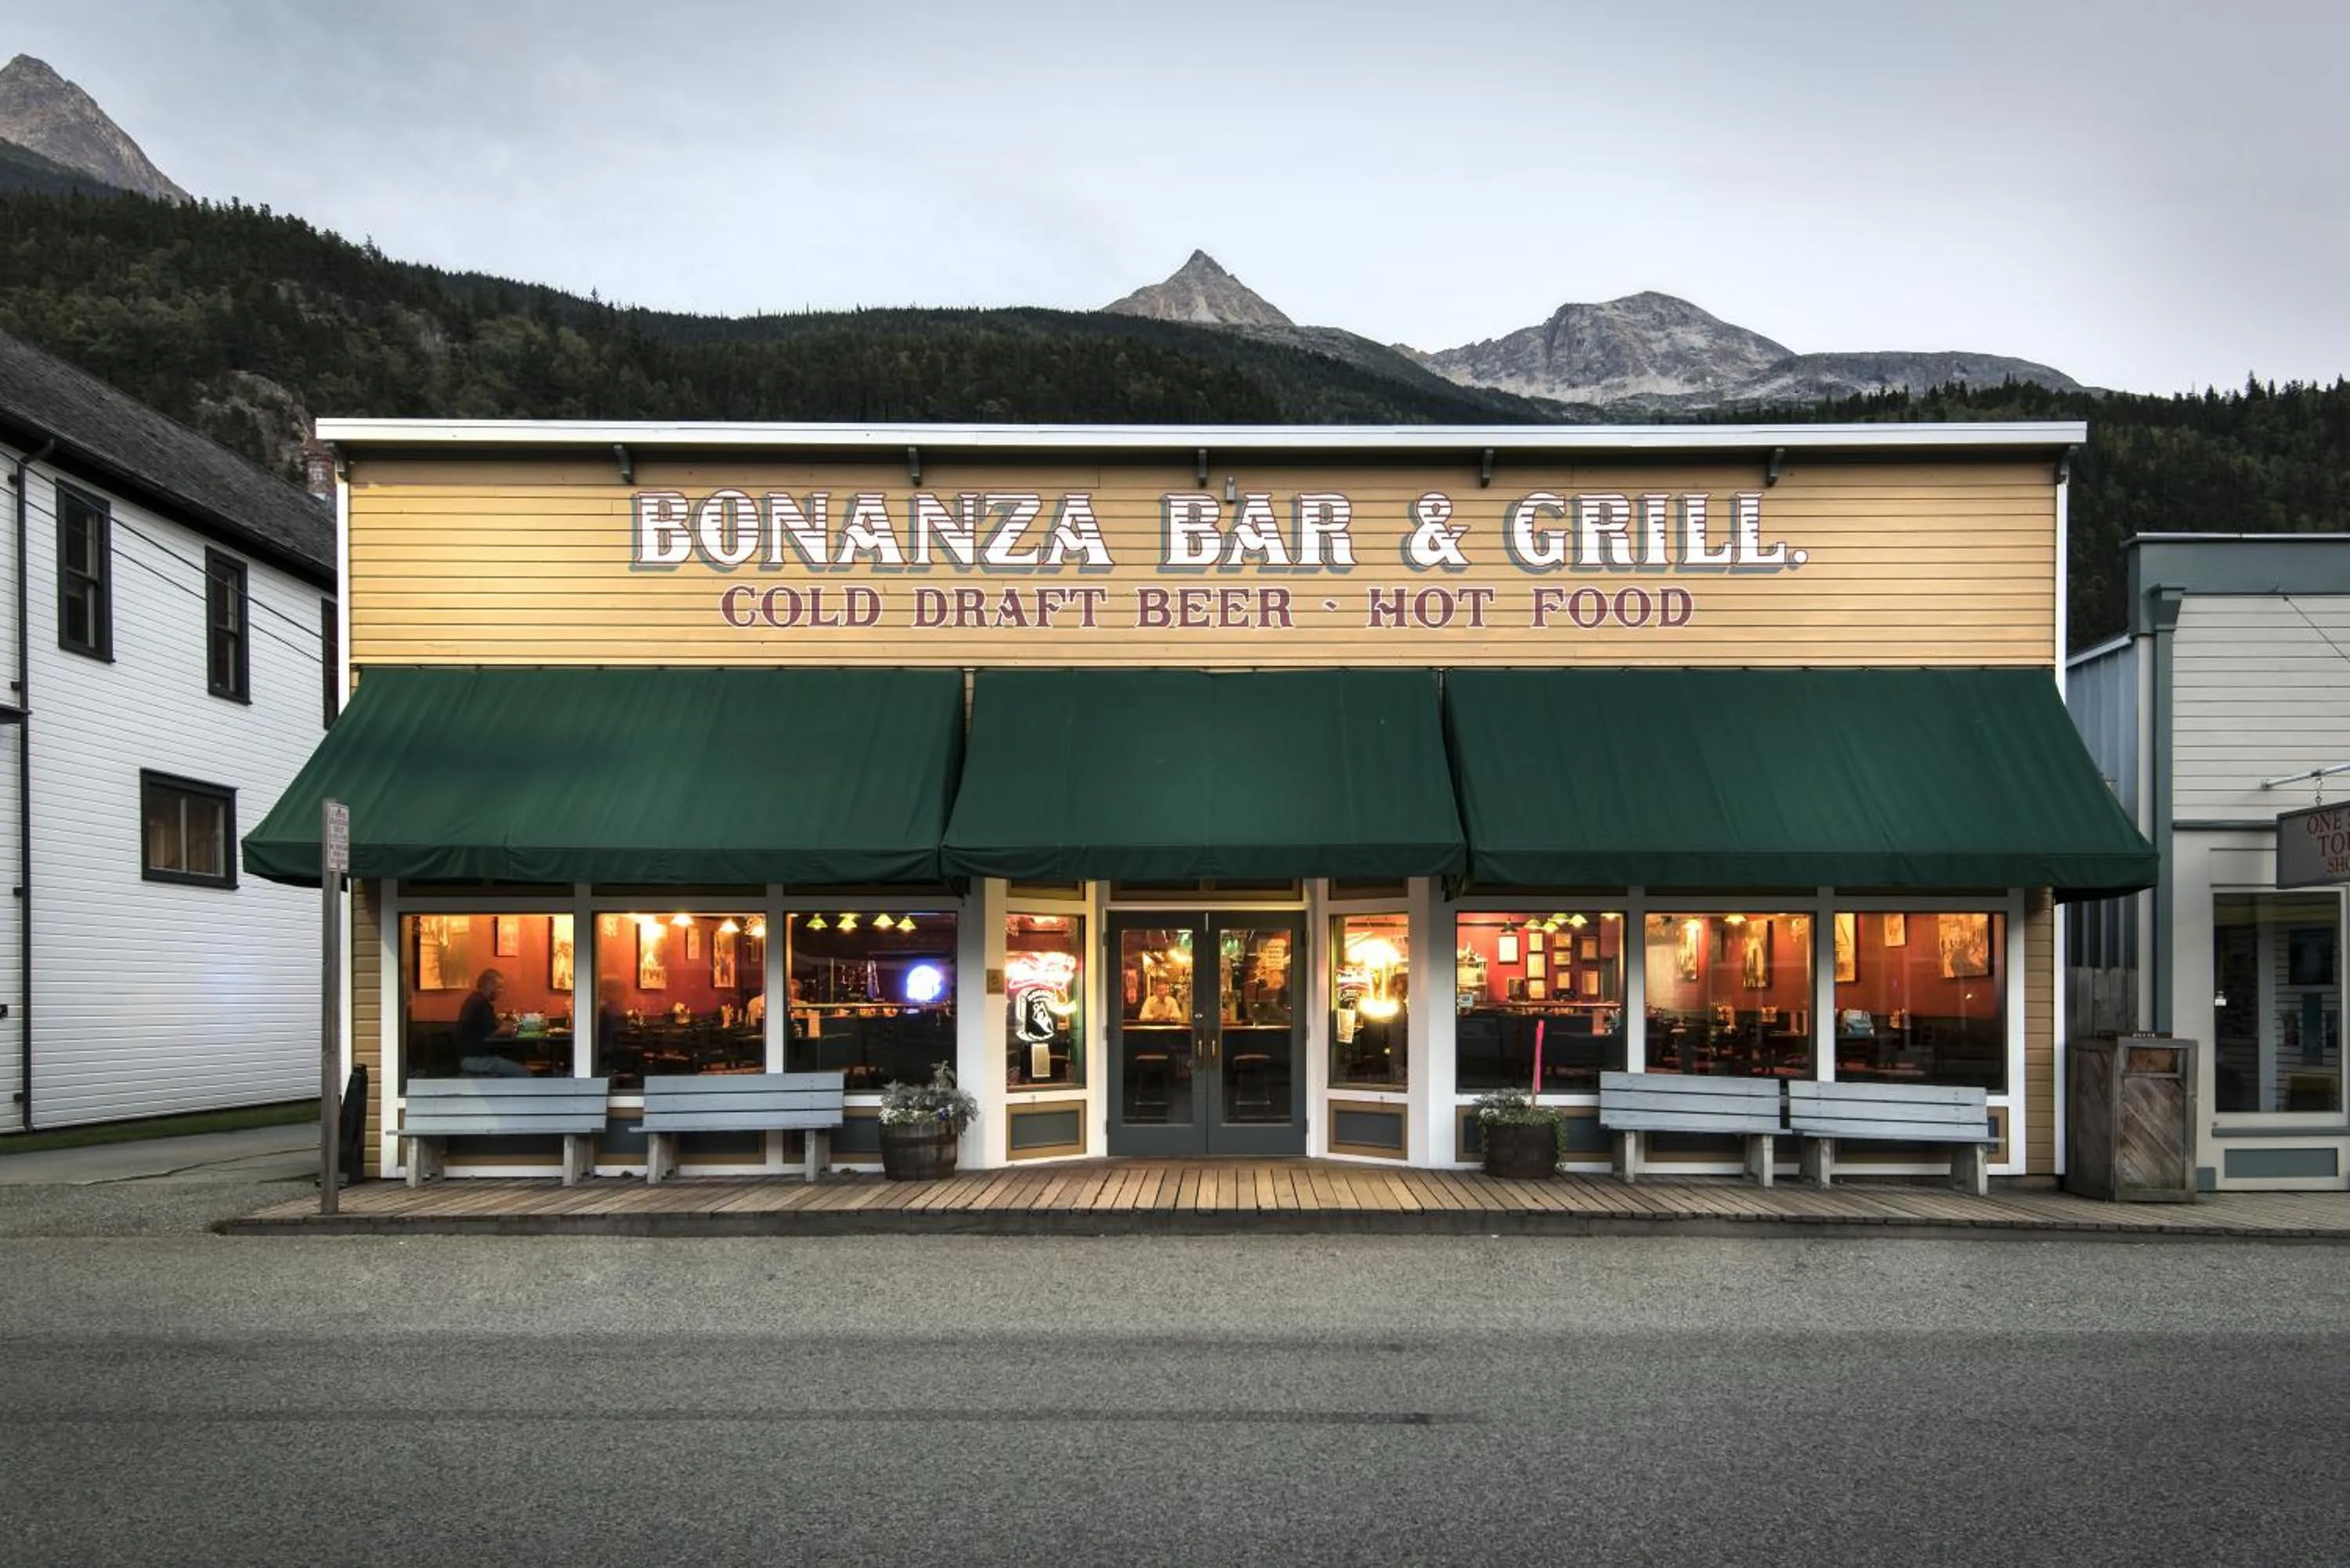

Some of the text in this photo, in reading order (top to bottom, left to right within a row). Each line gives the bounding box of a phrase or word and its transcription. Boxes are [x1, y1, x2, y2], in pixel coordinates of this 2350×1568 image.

[629, 490, 1809, 573] BONANZA BAR & GRILL.
[720, 585, 882, 628] COLD
[912, 587, 1107, 628] DRAFT
[1136, 587, 1294, 628] BEER
[1366, 587, 1495, 628] HOT
[1531, 587, 1693, 628] FOOD
[2307, 811, 2341, 836] ONE
